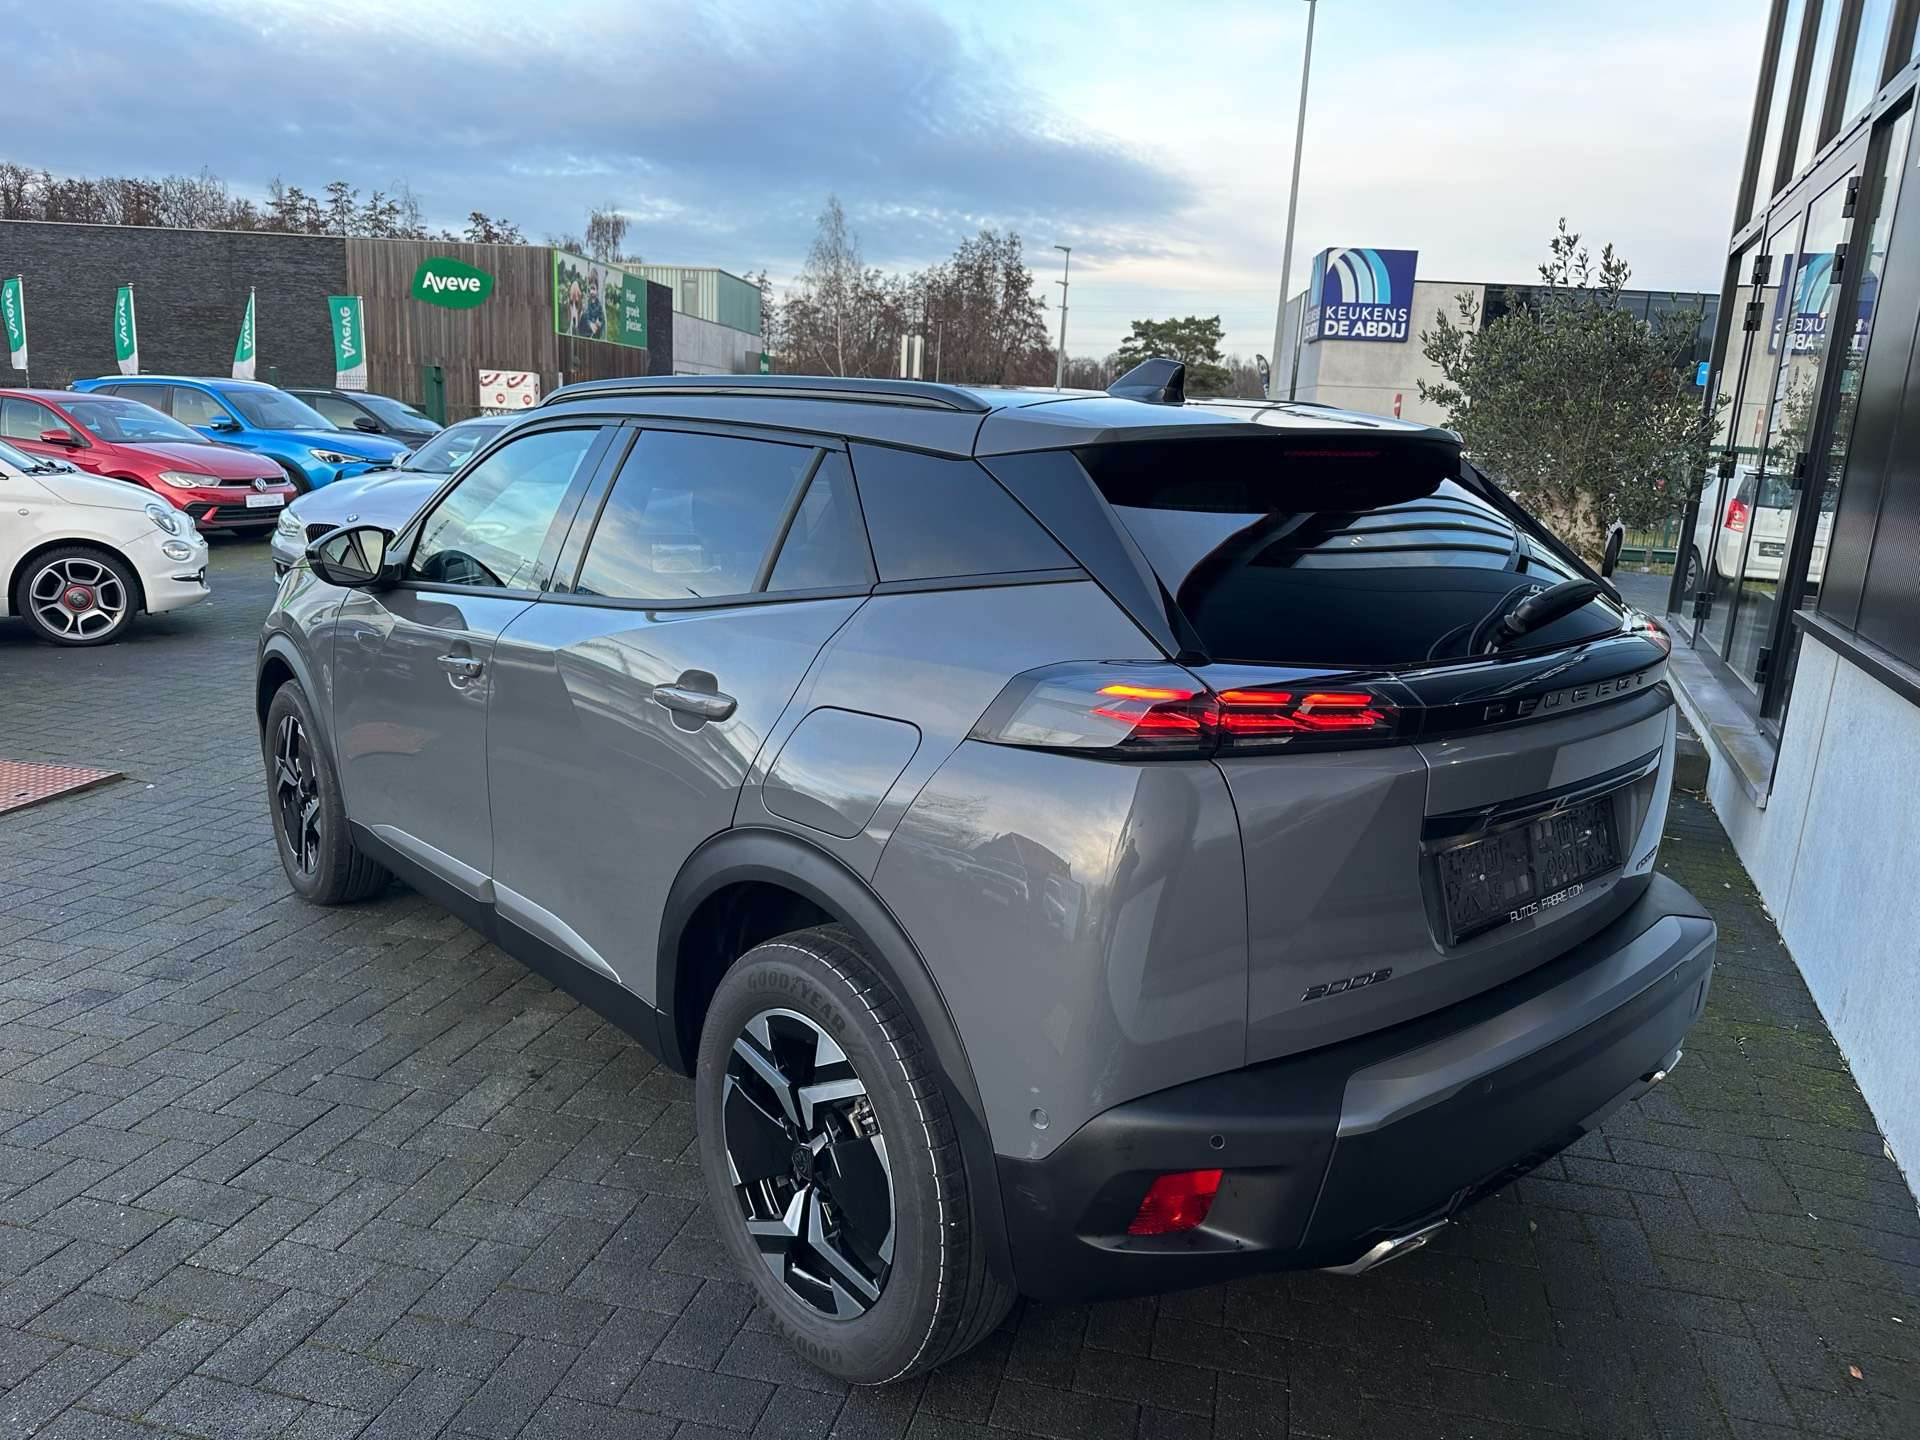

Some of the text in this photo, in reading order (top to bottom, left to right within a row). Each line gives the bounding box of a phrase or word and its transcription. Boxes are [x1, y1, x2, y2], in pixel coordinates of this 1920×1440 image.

[422, 271, 481, 294] Aveve
[1326, 306, 1407, 321] KEUKENS
[340, 306, 356, 359] Aveve
[1323, 320, 1350, 337] DE
[1352, 321, 1406, 338] ABDIJ
[1483, 671, 1647, 721] PEUGEOT
[1510, 902, 1539, 923] AUTOS
[1300, 966, 1393, 1002] 2008
[748, 970, 846, 1032] GOODYEAR
